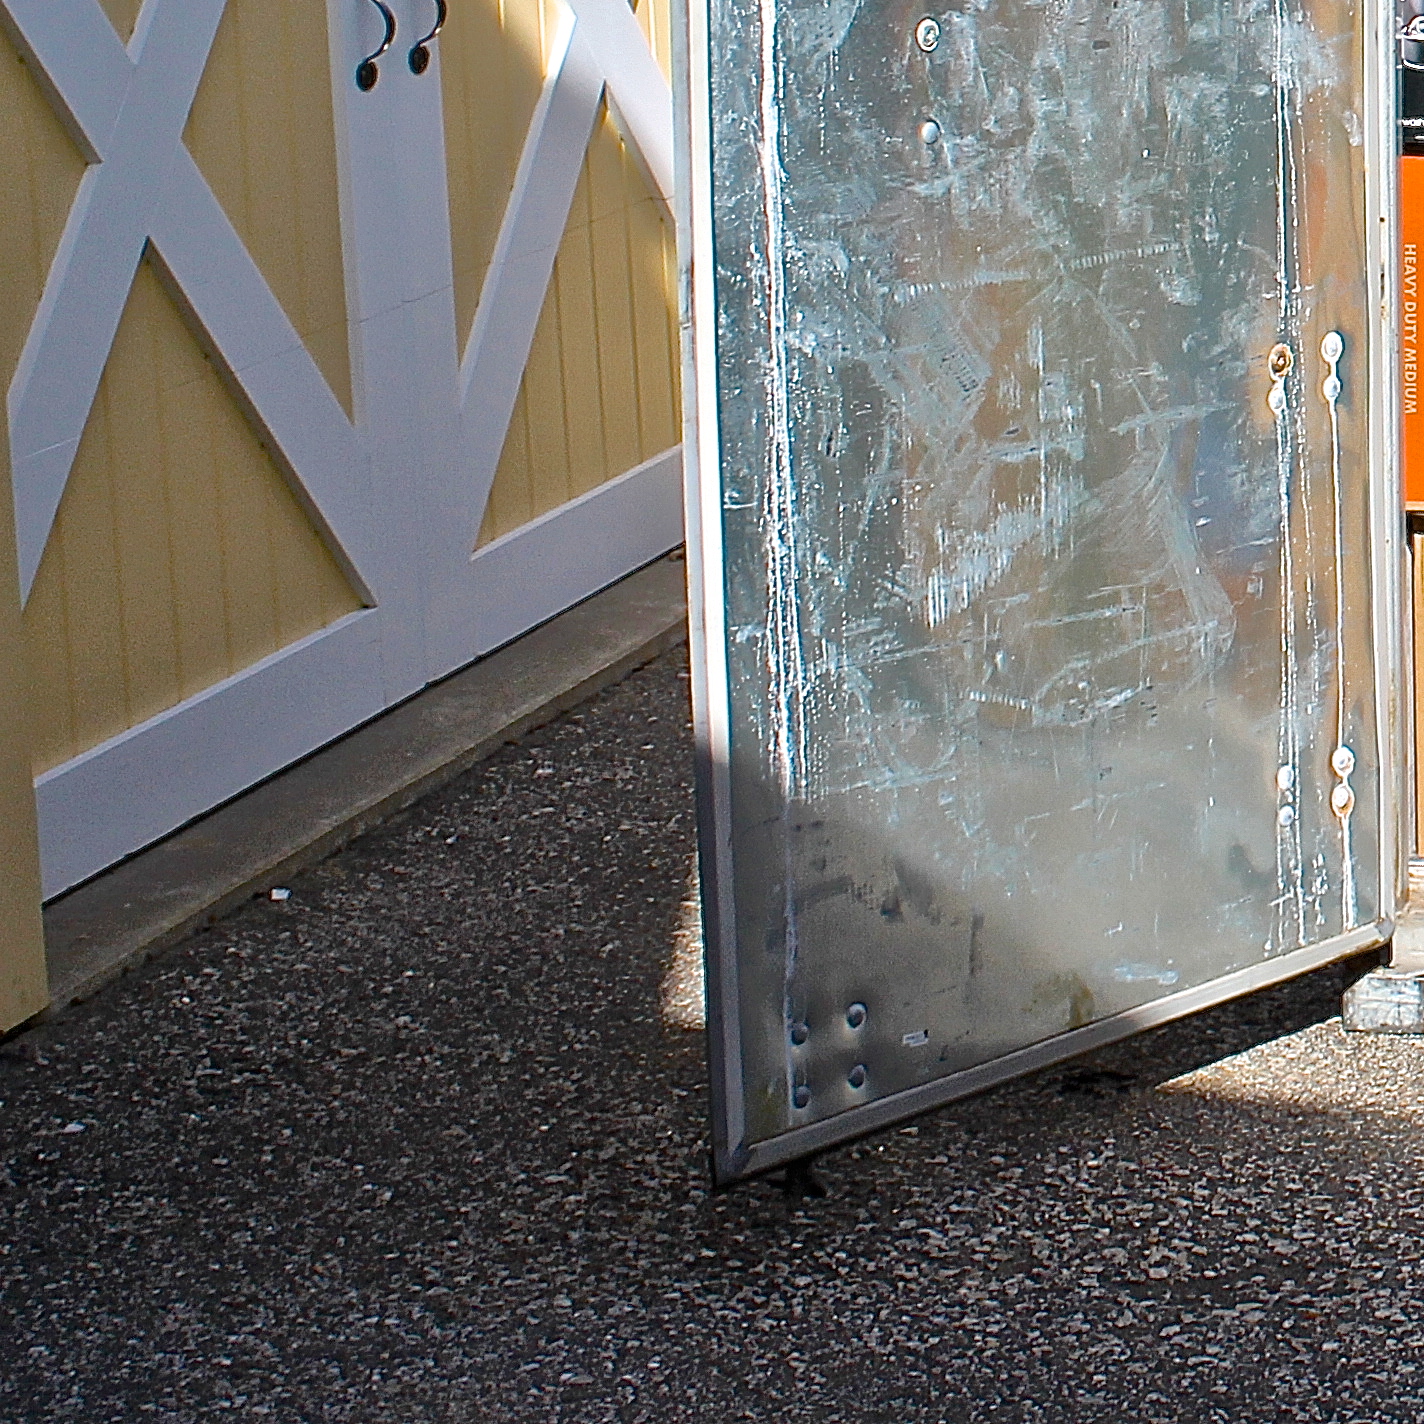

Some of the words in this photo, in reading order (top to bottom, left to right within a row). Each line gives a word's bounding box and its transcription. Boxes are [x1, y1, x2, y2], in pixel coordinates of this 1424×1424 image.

[1404, 243, 1418, 291] HEAVY
[1405, 296, 1418, 343] DUTY
[1405, 347, 1418, 414] MEDIUM
